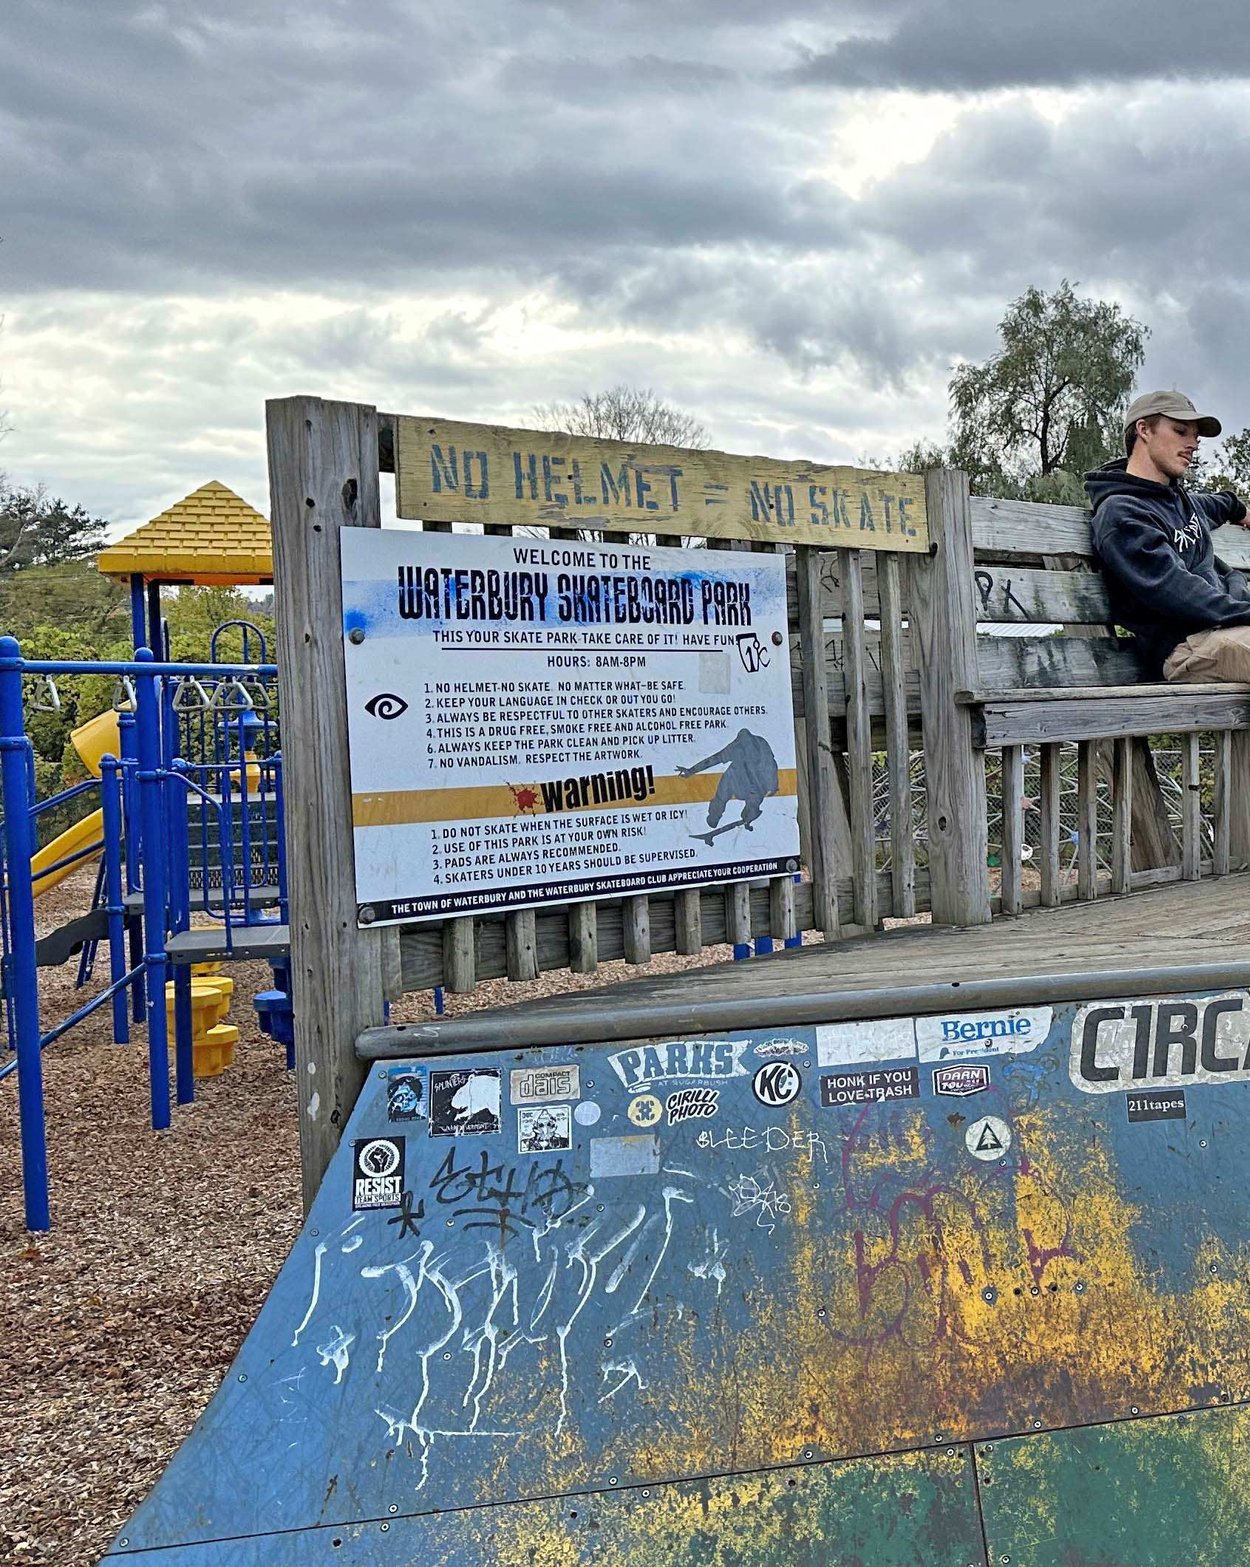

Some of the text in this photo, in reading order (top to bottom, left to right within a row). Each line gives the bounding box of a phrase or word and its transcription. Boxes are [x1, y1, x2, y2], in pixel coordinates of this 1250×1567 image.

[430, 444, 489, 499] NO
[513, 451, 684, 511] HELMET
[750, 480, 795, 527] NO
[809, 484, 917, 537] SKATE
[513, 548, 651, 571] WELCOME TO THE
[398, 566, 548, 621] WATERBURY
[557, 573, 695, 625] SKATEBOARD
[702, 579, 752, 626] PARK
[433, 630, 463, 643] THIS
[465, 630, 500, 643] YOUR
[504, 631, 543, 644] SKATE
[615, 633, 644, 645] CARE
[647, 633, 660, 645] OF
[663, 633, 678, 645] IT!
[682, 634, 710, 646] HAVE
[547, 655, 646, 668] HOURS: 8AM-8PM
[424, 682, 433, 693] 1.
[435, 682, 450, 693] NO
[558, 681, 571, 691] NO
[574, 681, 612, 691] MATTER
[661, 680, 686, 690] SAFE.
[425, 694, 676, 709] 2. KEEP YOUR LANGUAGE IN CHECK OR OUT YOU GO!
[425, 705, 768, 724] 3. ALWAYS BE RESPECTFUL TO OTHER SKATERS AND ENCOURAGE OTHERS.
[426, 728, 436, 738] 4.
[437, 727, 462, 738] THIS
[465, 726, 475, 737] IS
[478, 726, 486, 736] A
[489, 725, 516, 736] DRUG
[519, 724, 549, 736] FREE,
[550, 723, 585, 734] SMOKE
[636, 721, 677, 732] ALCOHOL
[679, 720, 702, 730] FREE
[427, 734, 696, 754] 6. ALWAYS KEEP THE PARK CLEAN AND PICK UP LITTER.
[428, 750, 643, 769] 7. NO VANDALISM. RESPECT THE ARTWORK.
[431, 809, 688, 840] 1. DO NOT SKATE WHEN THE SURFACE IS WET OR ICY!
[432, 826, 647, 854] 2. USE OF THIS PARK IS AT YOUR OWN RISK!
[433, 843, 621, 870] 3. PADS ARE ALWAYS RECOMMENDED.
[433, 848, 698, 885] 4. SKATERS UNDER 10 YEARS SHOULD BE SUPERVISED.
[392, 862, 778, 914] THE TOWN OF WATERBURY AND THE WATERBURY SKATEBOARD CLUB APPRECIATE YOUR COOPERATION
[940, 1016, 1031, 1041] Bernie
[534, 1071, 571, 1079] COMPACT
[758, 1065, 792, 1102] KC
[827, 1070, 912, 1089] HONK IF YOU
[828, 1085, 912, 1104] LOVE TRASH
[669, 1104, 716, 1124] PHOTO
[1127, 1096, 1185, 1114] 211tapes
[355, 1176, 402, 1197] RESIST
[374, 1193, 400, 1203] SPORTS
